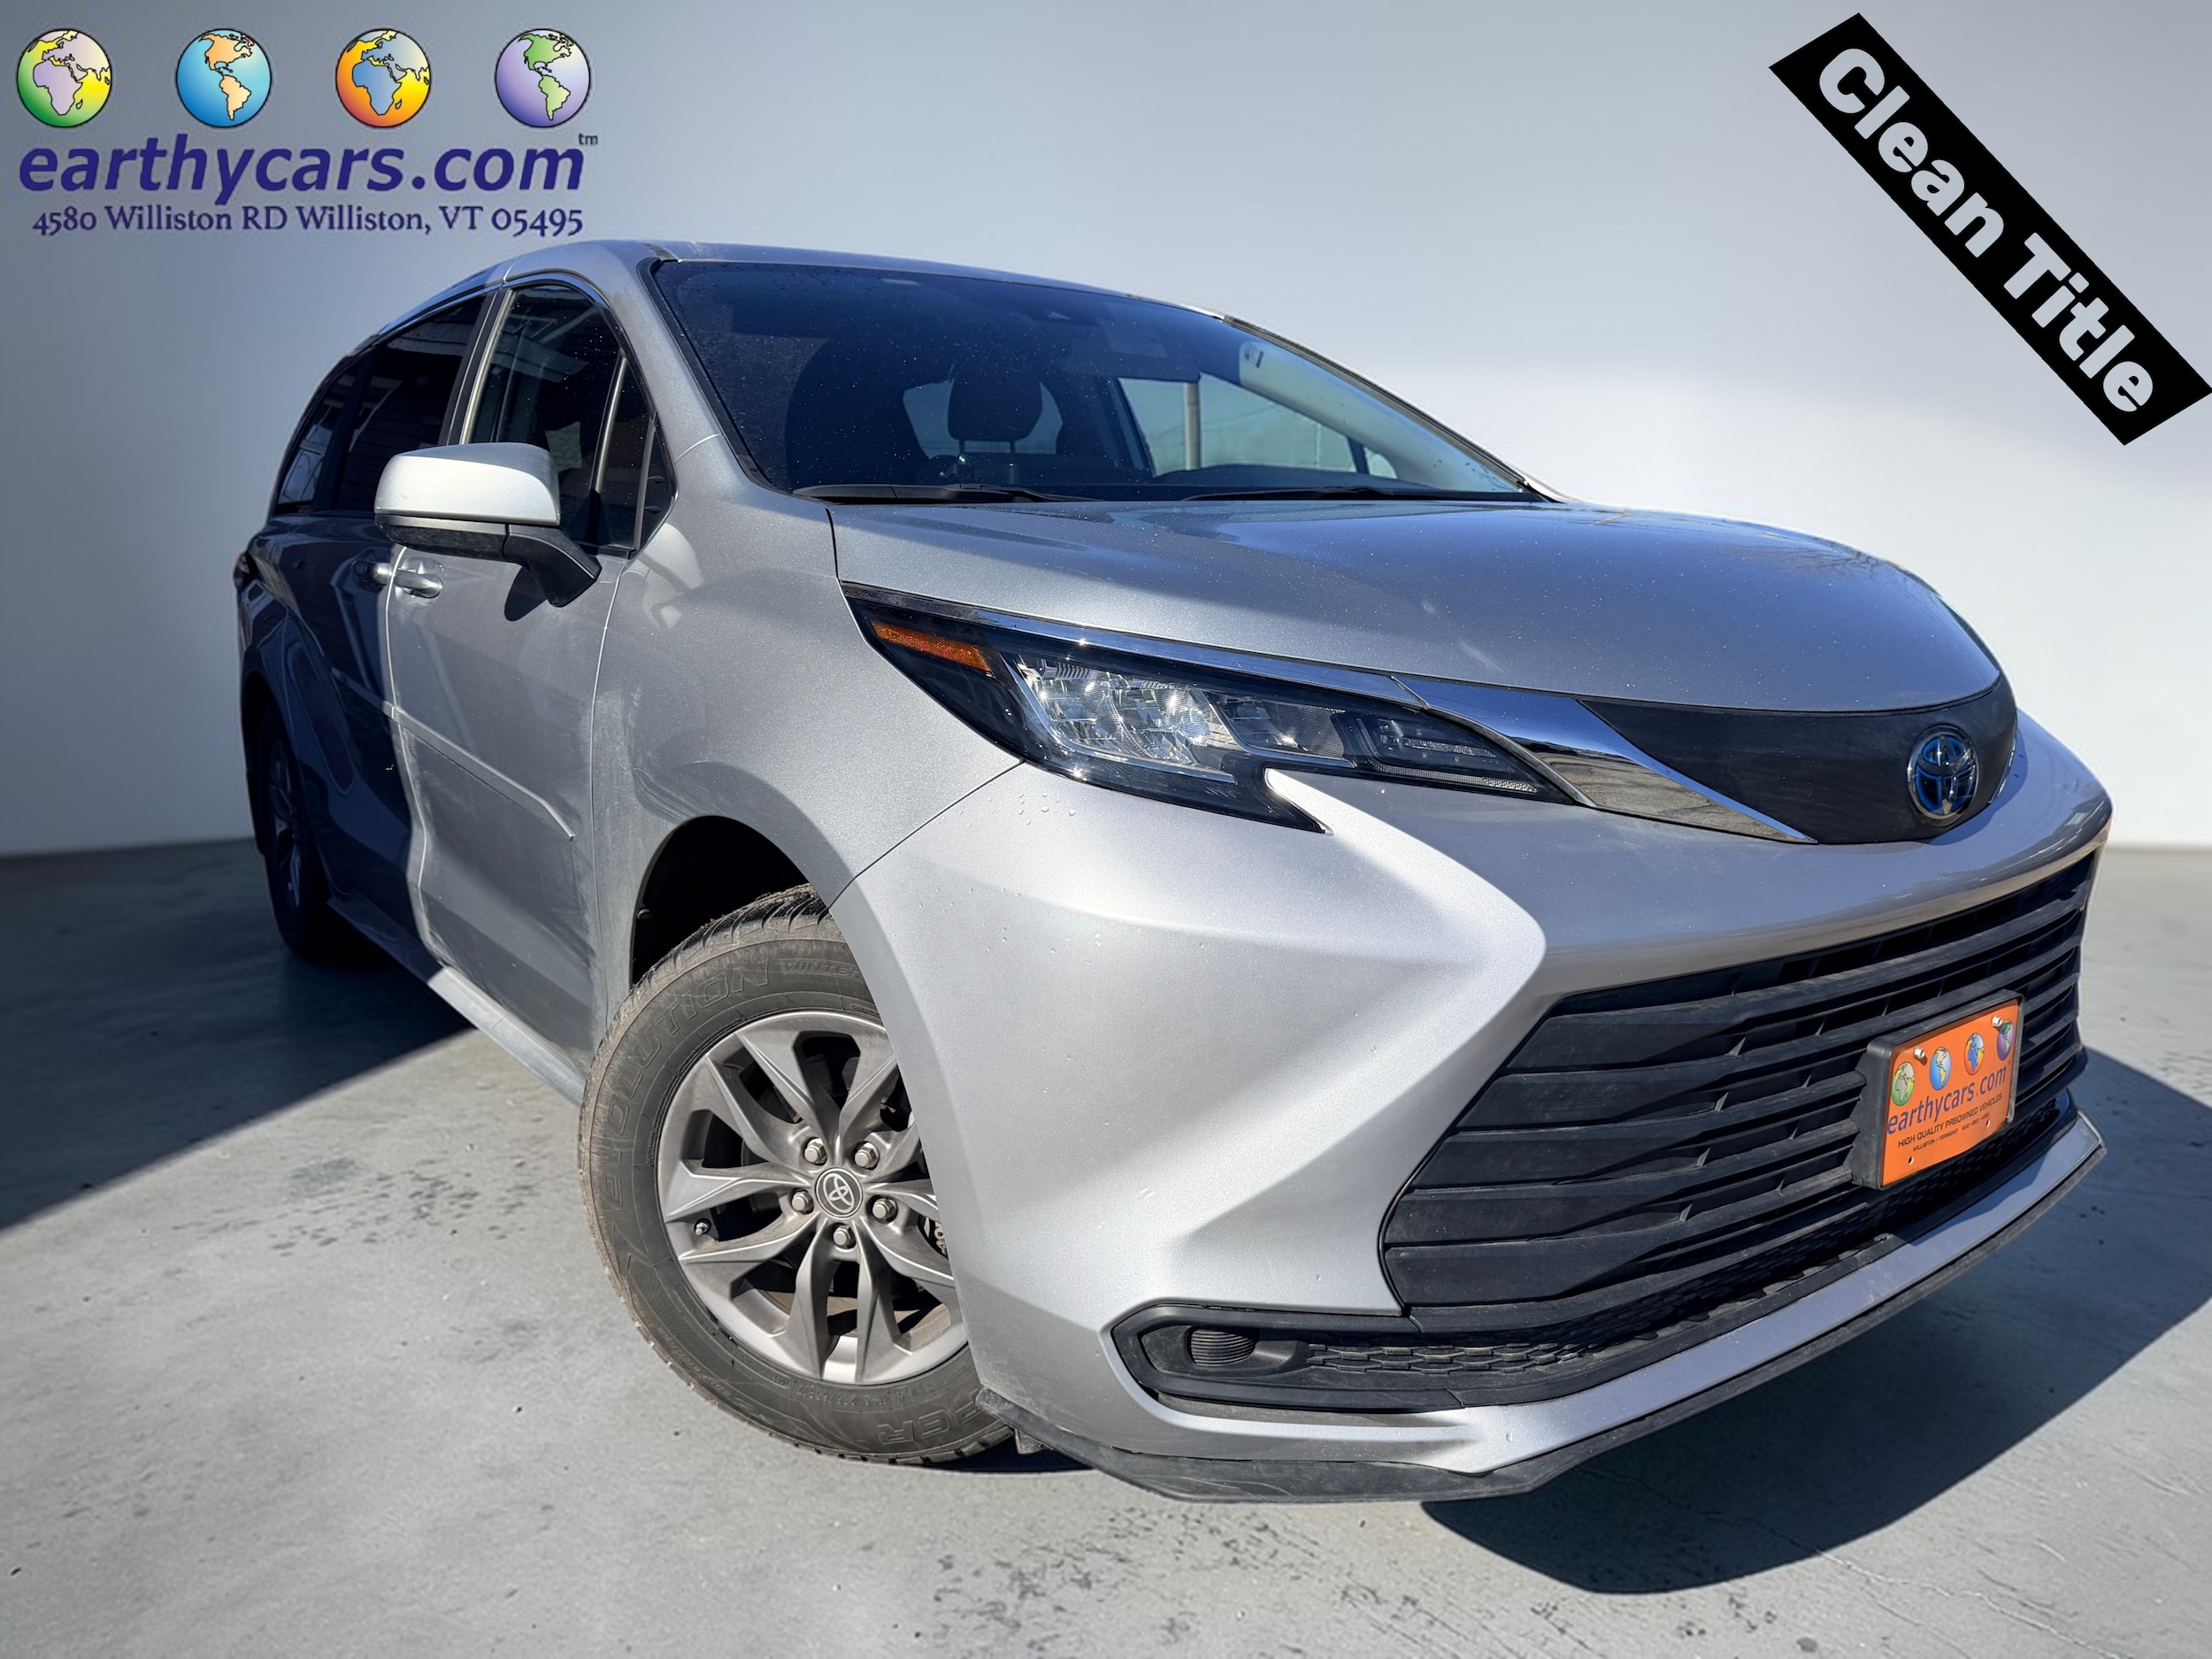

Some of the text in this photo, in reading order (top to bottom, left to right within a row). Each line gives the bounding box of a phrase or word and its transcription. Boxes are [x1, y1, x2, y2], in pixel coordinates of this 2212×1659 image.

[1887, 1066, 2007, 1134] earthycars.com
[1898, 1132, 1916, 1148] HIGH
[1916, 1123, 1944, 1141] QUALITY
[1945, 1106, 1978, 1128] PREOWNED
[1979, 1093, 2002, 1112] VEHICLES
